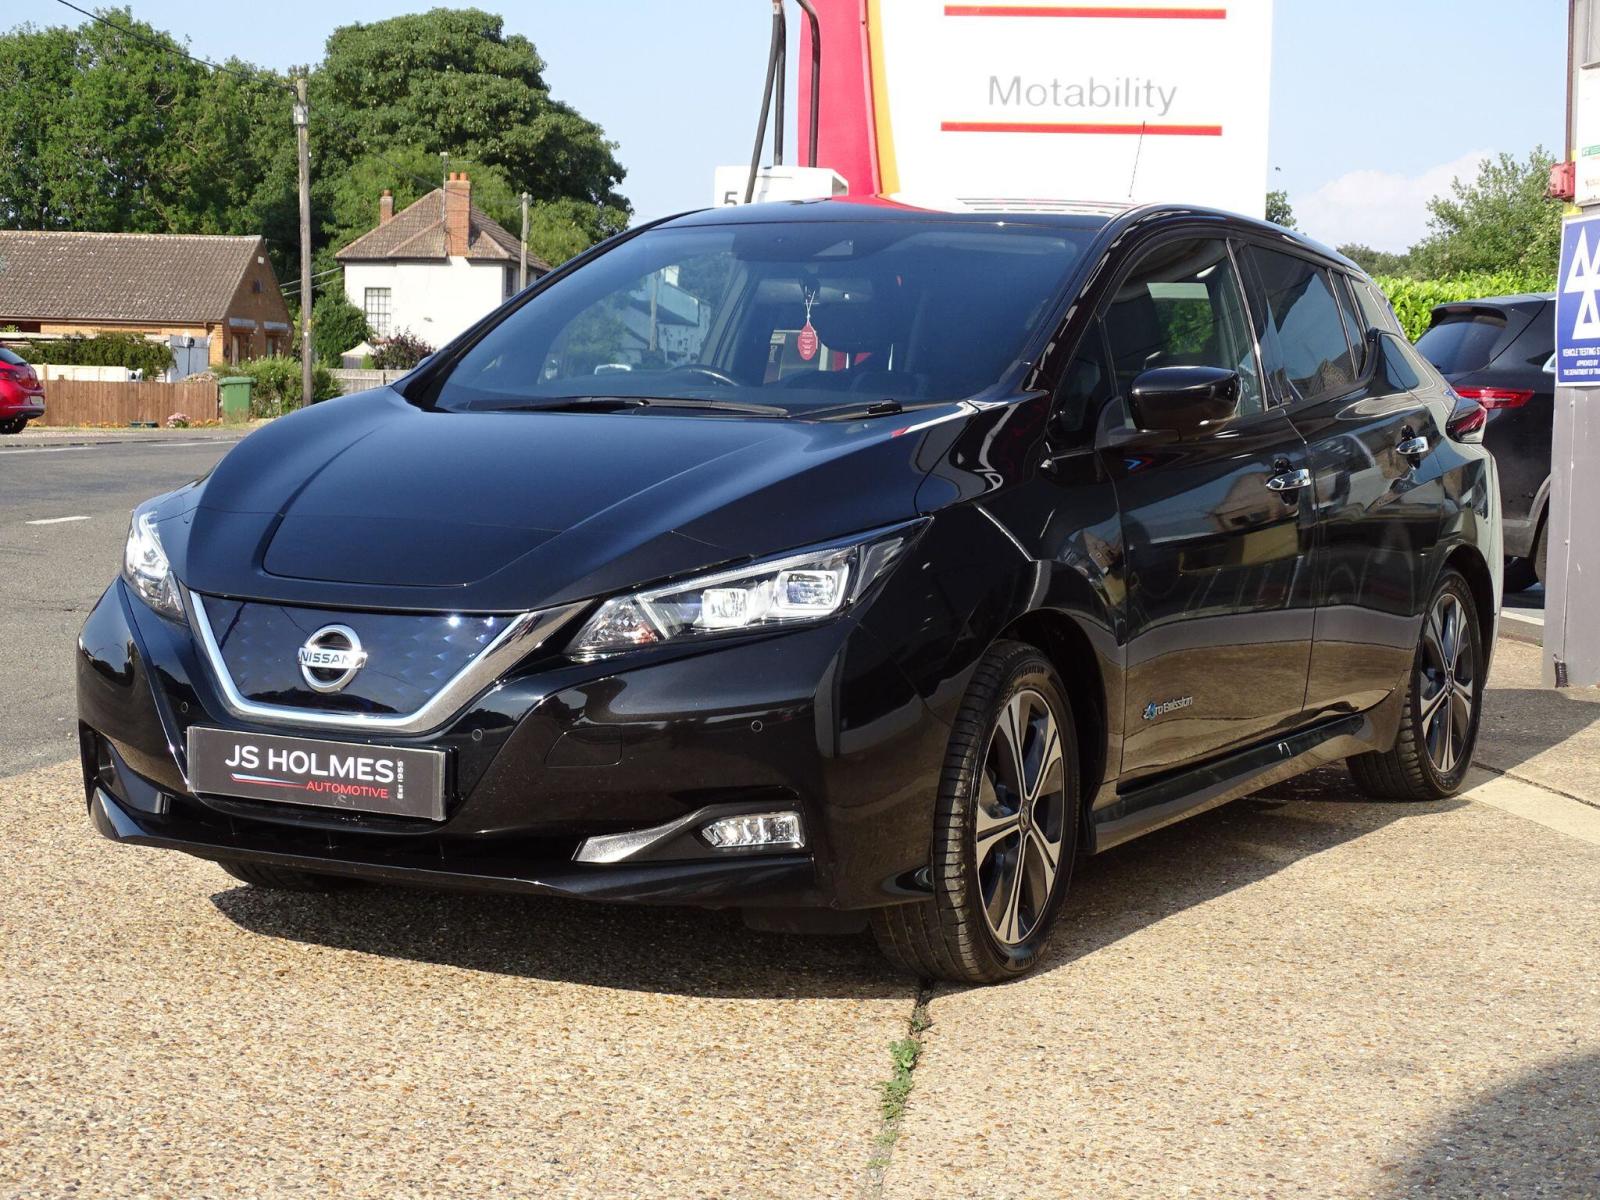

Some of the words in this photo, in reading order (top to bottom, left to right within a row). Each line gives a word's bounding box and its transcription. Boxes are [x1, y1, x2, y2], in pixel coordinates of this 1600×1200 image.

[988, 75, 1178, 117] Motability
[299, 650, 351, 666] NISSA
[224, 744, 260, 769] JS
[268, 748, 394, 783] HOLMES
[396, 760, 404, 783] 1955
[306, 780, 389, 799] AUTOMOTIVE
